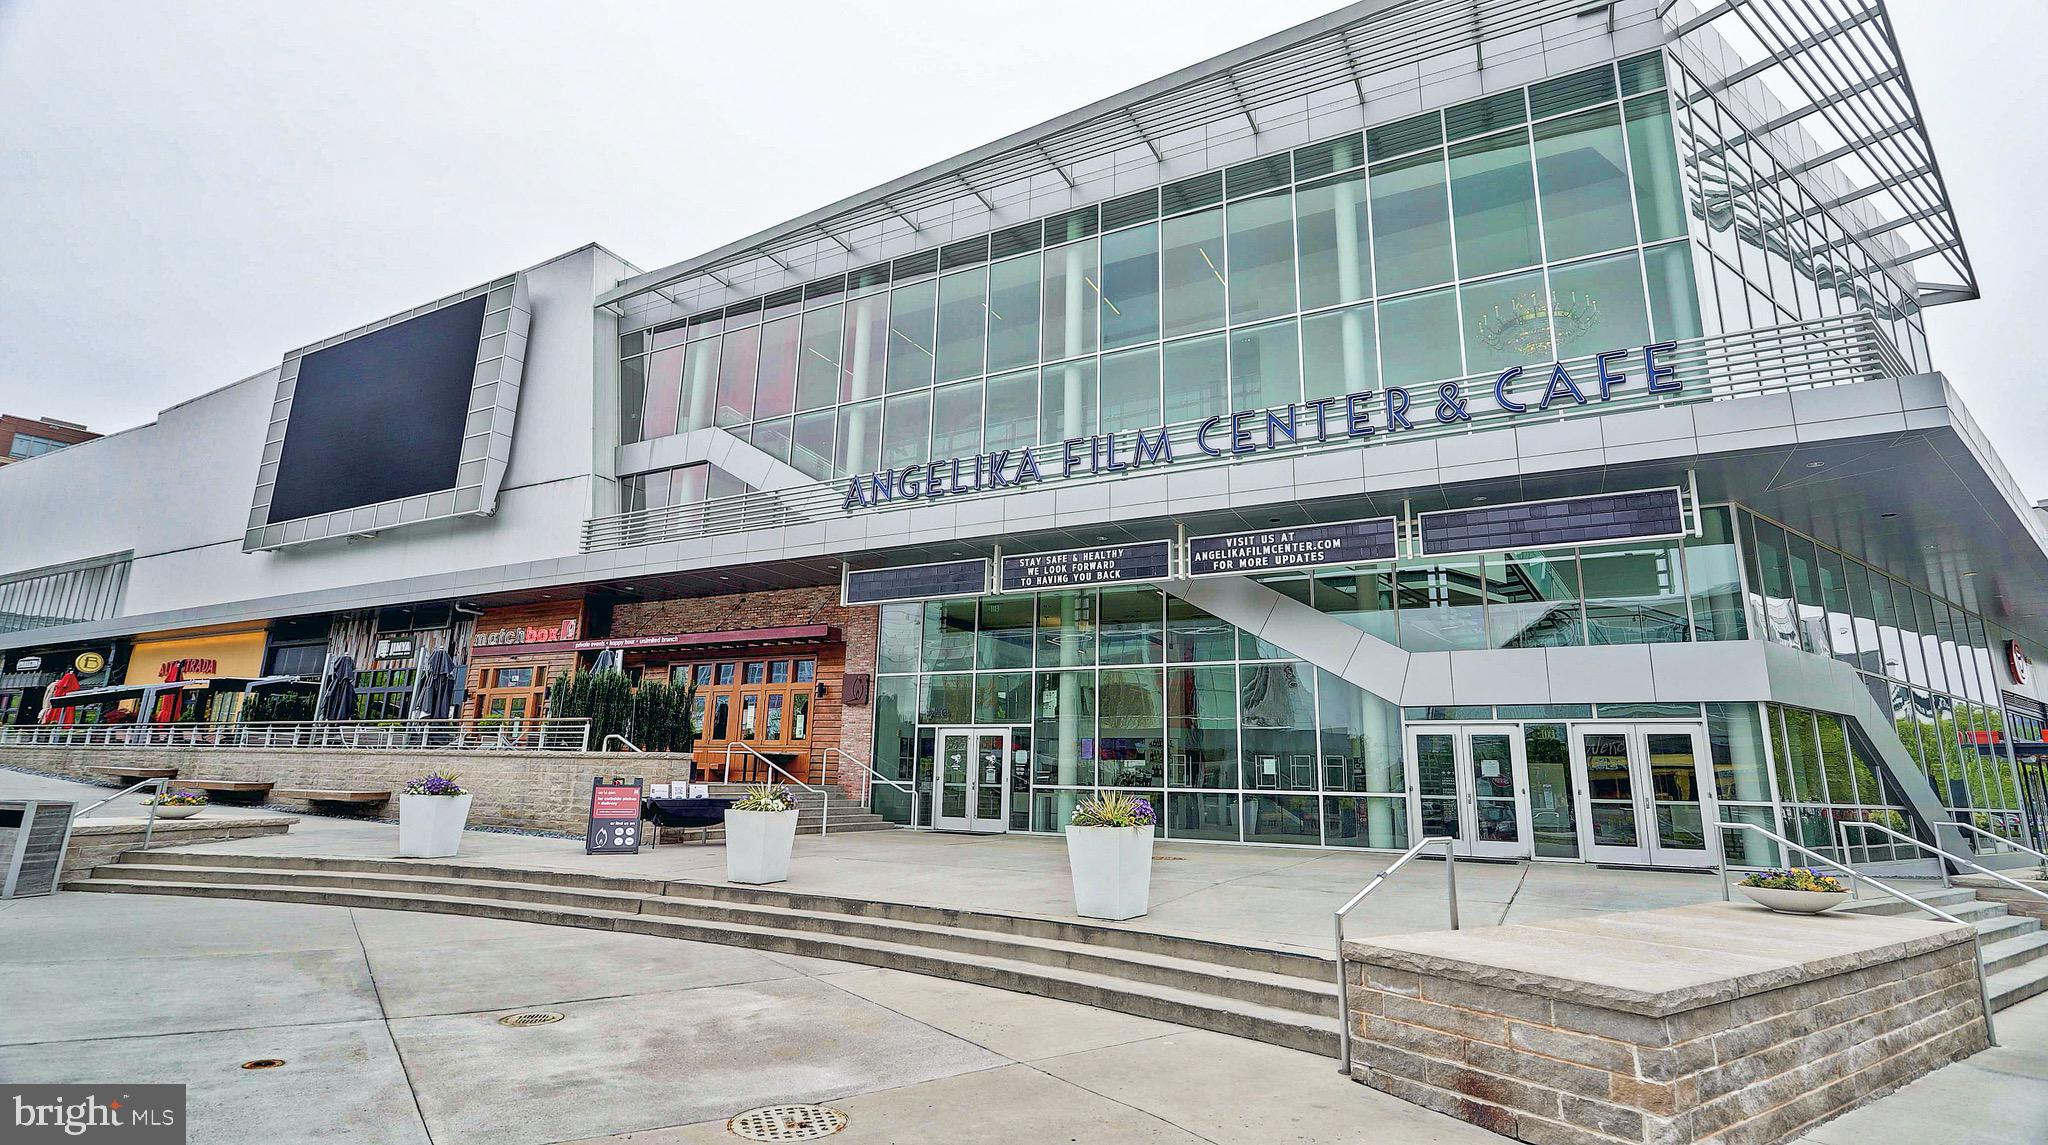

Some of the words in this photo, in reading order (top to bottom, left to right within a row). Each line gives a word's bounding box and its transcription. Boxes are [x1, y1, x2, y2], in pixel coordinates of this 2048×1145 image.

[841, 446, 1043, 510] ANGELIKA
[1062, 424, 1174, 479] FILM
[1197, 372, 1414, 457] CENTER
[1434, 381, 1472, 424] &
[1493, 340, 1684, 414] CAFE
[1226, 536, 1255, 548] VISIT
[1261, 534, 1275, 544] US
[1281, 532, 1295, 542] AT
[1019, 557, 1041, 567] STAY
[1046, 554, 1067, 565] SAFE
[1072, 553, 1078, 562] &
[1083, 549, 1124, 561] HEALTHY
[1195, 539, 1341, 561] ANGELIKAFILMCENTER.COM
[1027, 567, 1039, 576] WE
[1044, 564, 1067, 574] LOOK
[1072, 560, 1115, 572] FORWARD
[1213, 558, 1233, 570] FOR
[1239, 556, 1269, 568] MORE
[1275, 551, 1325, 565] UPDATES
[1021, 577, 1032, 586] TO
[1036, 573, 1069, 585] HAVING
[1073, 571, 1095, 583] YOU
[1097, 569, 1121, 580] BACK
[475, 626, 559, 646] matchbox
[609, 639, 624, 647] happy
